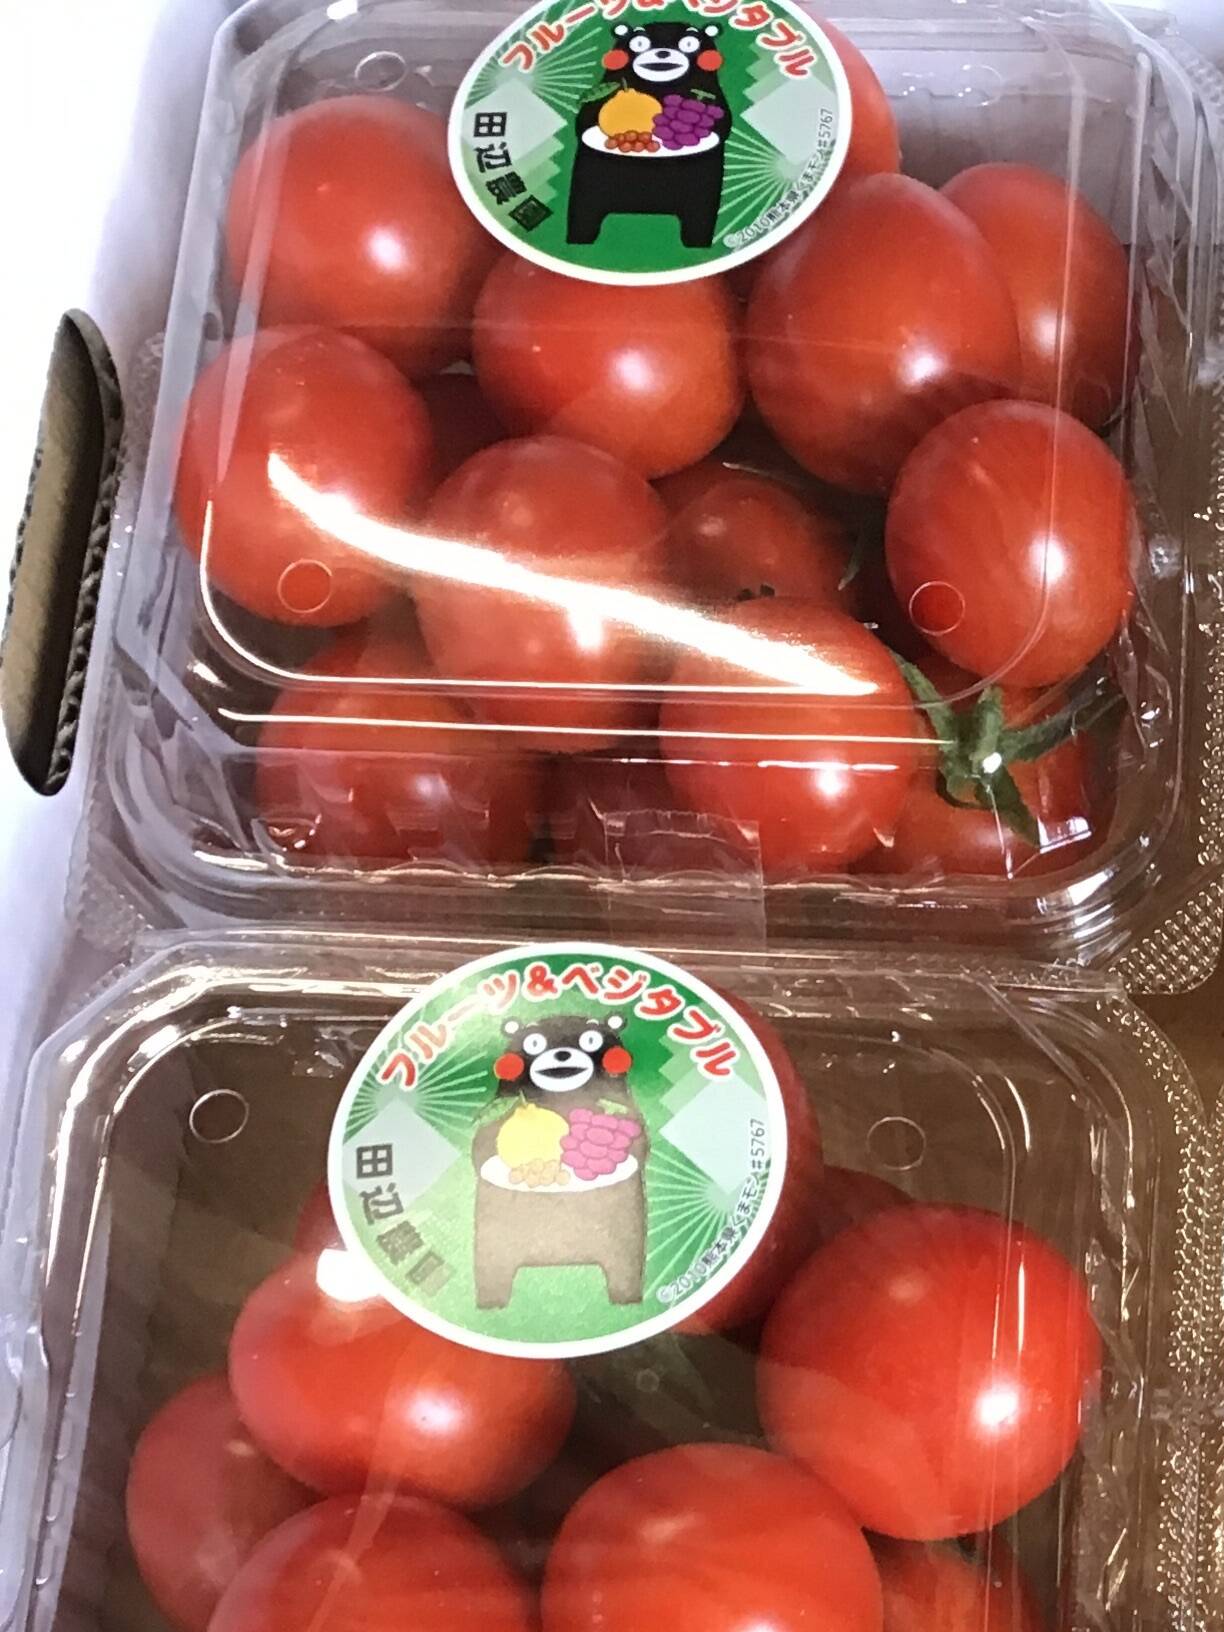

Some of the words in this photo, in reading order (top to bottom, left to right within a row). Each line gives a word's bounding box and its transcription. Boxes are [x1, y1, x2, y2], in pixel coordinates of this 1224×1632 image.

[380, 965, 736, 1087] フルーツ&ベジタブル
